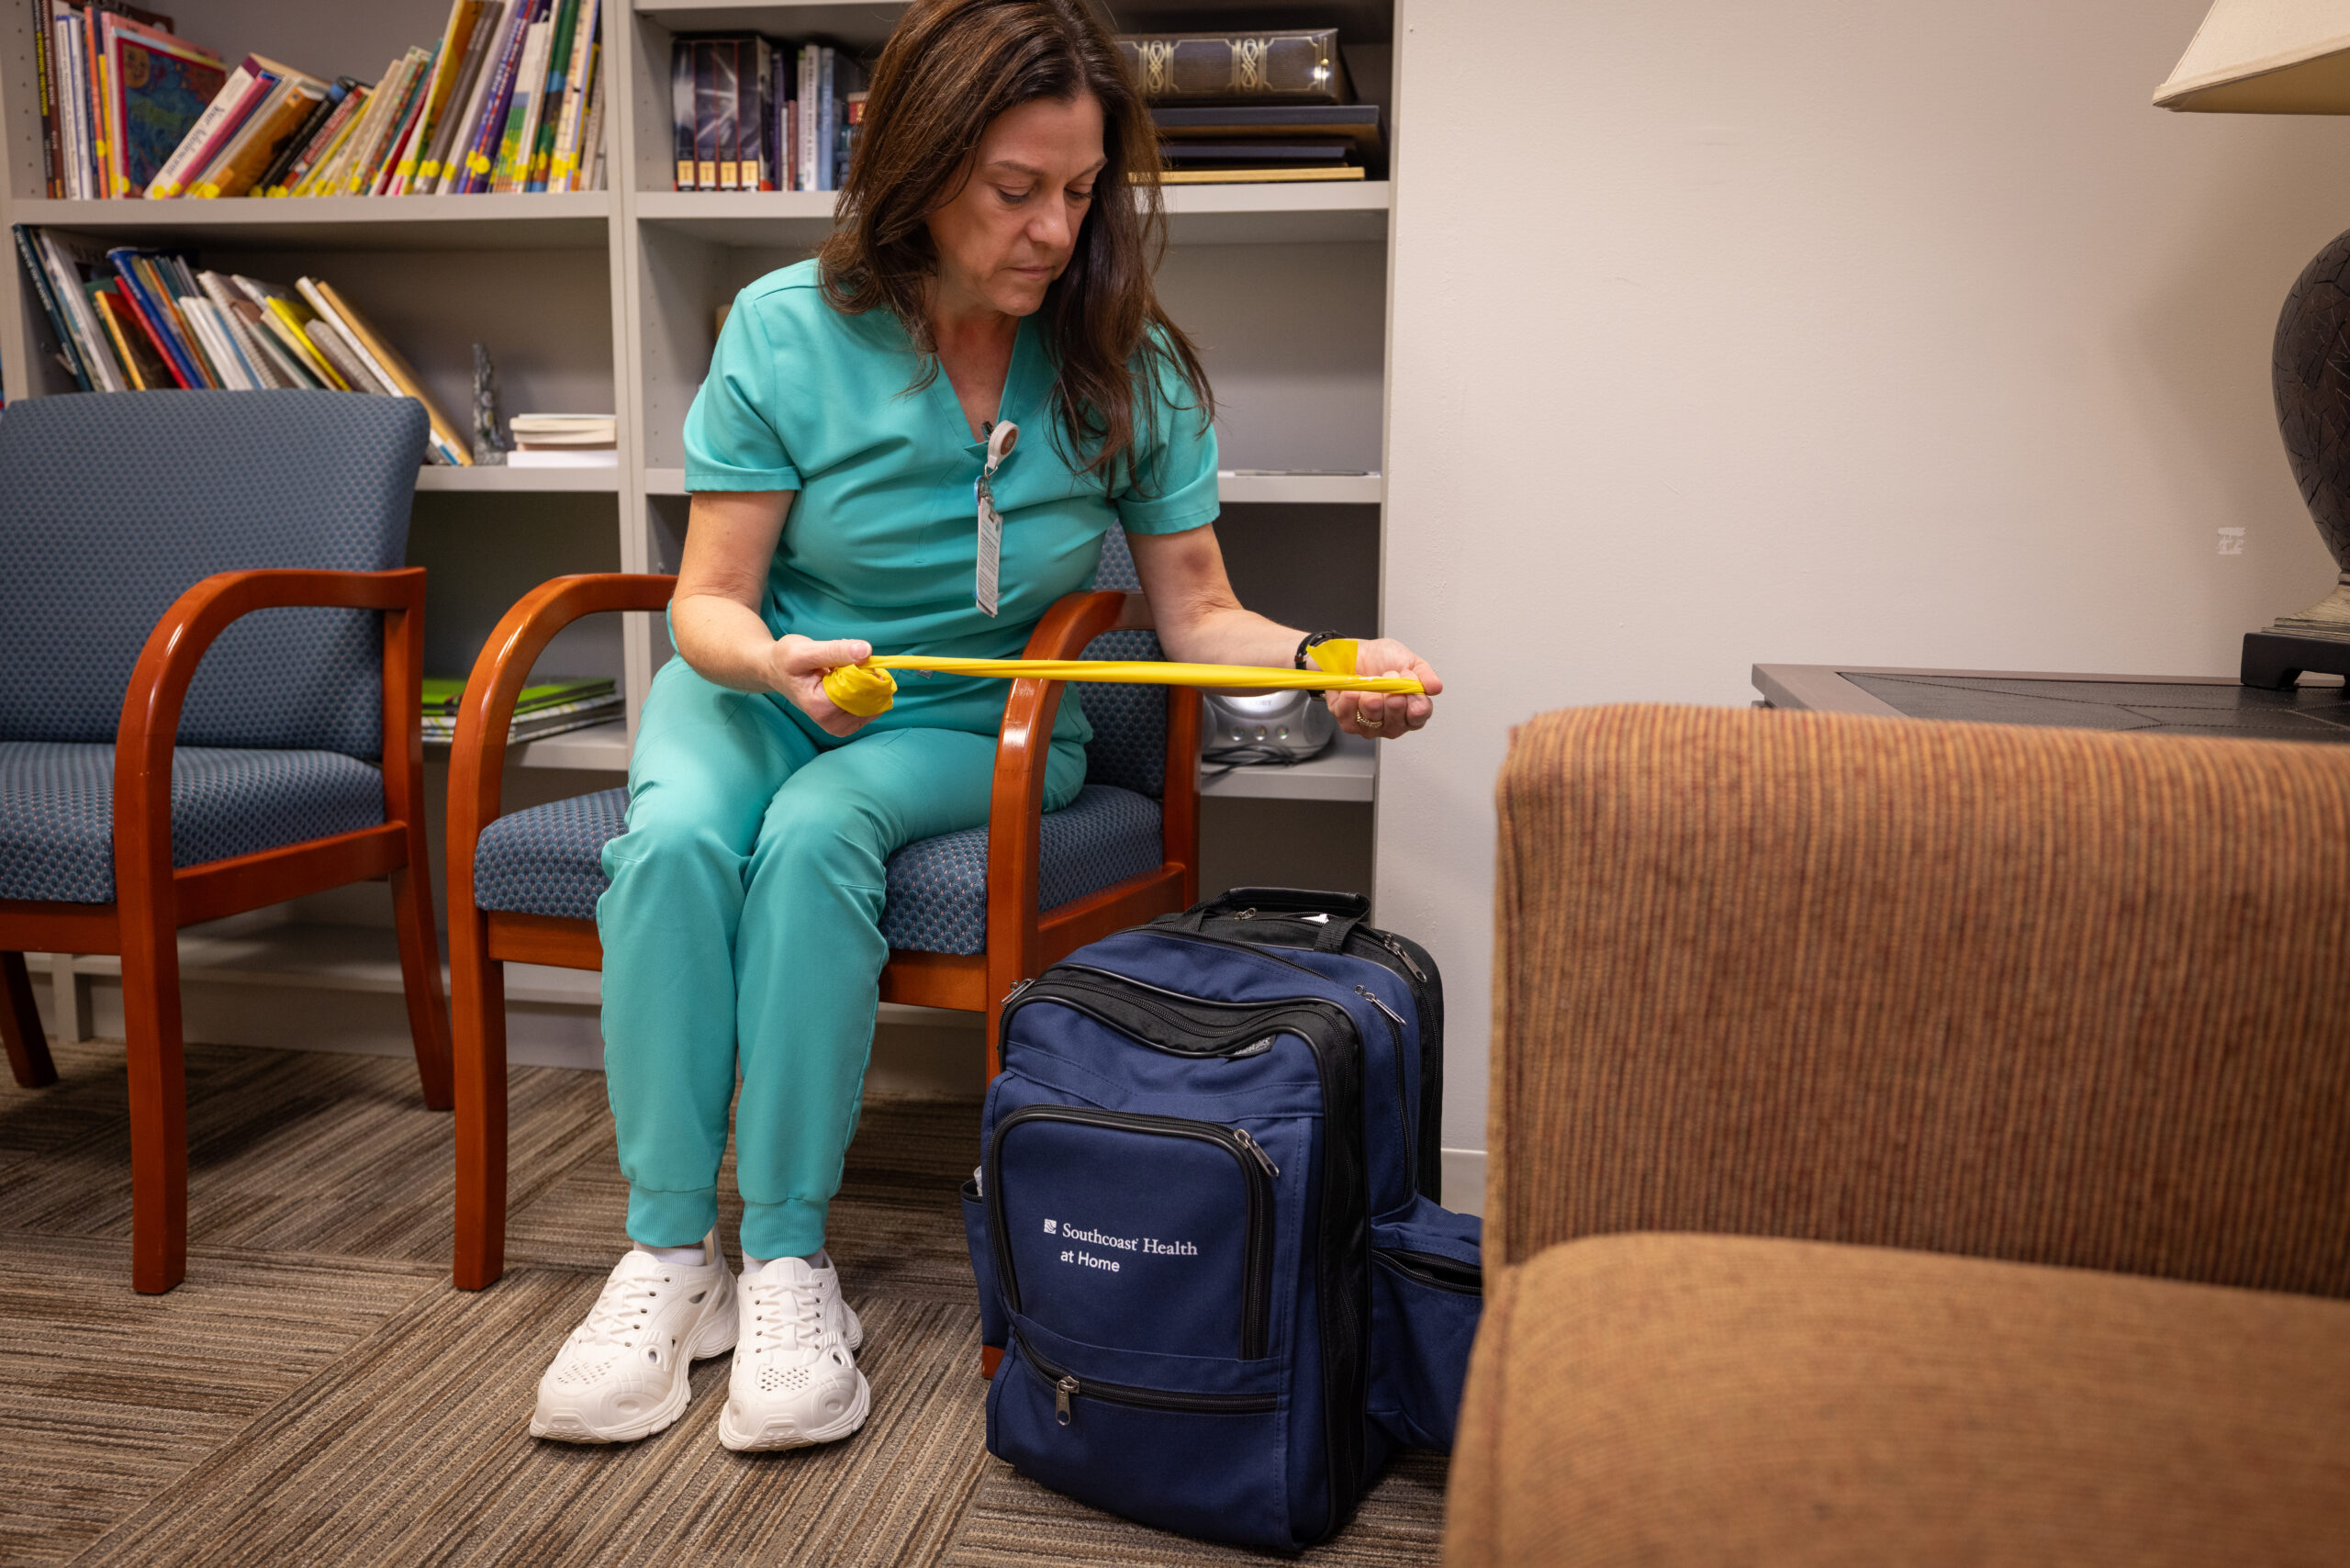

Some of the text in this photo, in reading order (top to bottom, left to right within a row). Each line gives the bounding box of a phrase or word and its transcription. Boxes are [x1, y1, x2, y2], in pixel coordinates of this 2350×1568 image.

[1062, 1222, 1199, 1256] Southcoast Health
[1060, 1249, 1121, 1272] at Home
